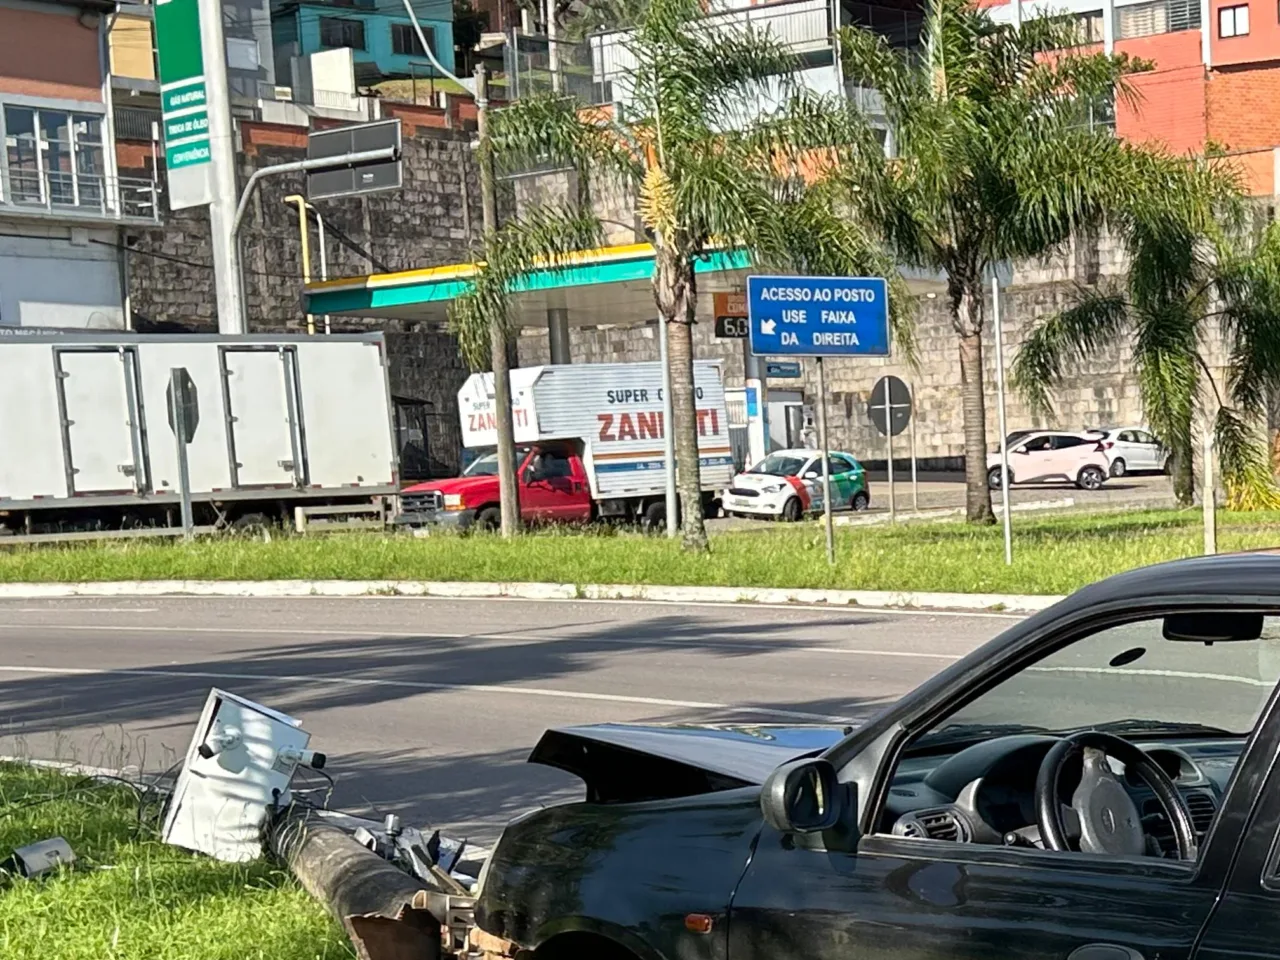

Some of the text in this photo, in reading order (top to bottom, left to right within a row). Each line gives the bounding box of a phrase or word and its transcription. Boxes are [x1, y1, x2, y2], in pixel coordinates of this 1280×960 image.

[761, 287, 811, 302] ACESSO
[813, 288, 832, 302] AO
[834, 288, 876, 303] POSTO
[782, 309, 857, 324] USE FAIXA
[781, 332, 860, 346] DA DIREITA
[607, 388, 649, 404] SUPER
[468, 408, 528, 432] ZANTI
[597, 408, 720, 442] ZANTI
